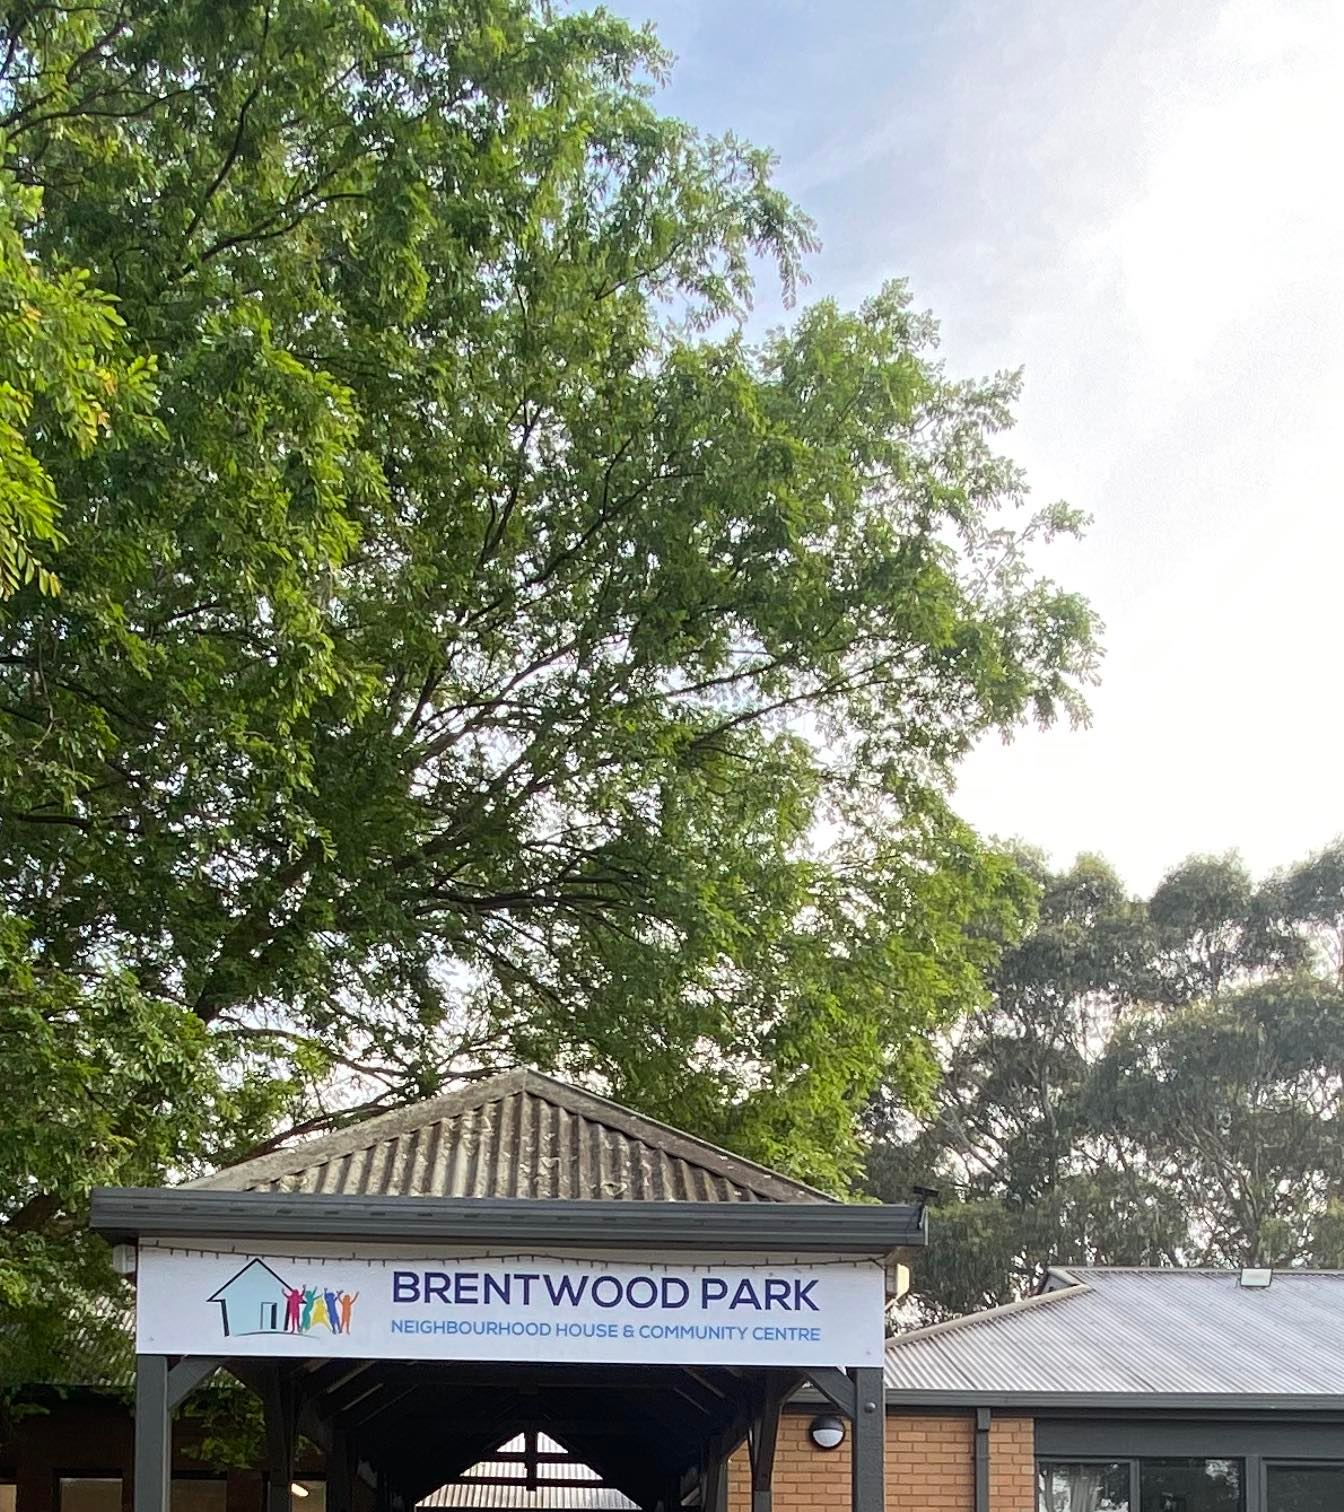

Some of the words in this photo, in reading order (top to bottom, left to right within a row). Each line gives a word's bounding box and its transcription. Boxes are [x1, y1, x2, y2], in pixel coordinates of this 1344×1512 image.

[392, 1271, 690, 1309] BRENTWOOD
[701, 1278, 820, 1311] PARK
[391, 1319, 552, 1337] NEIGHBOURHOOD
[556, 1323, 618, 1338] HOUSE
[622, 1325, 635, 1338] &
[639, 1324, 748, 1340] COMMUNITY
[752, 1327, 822, 1342] CENTRE
